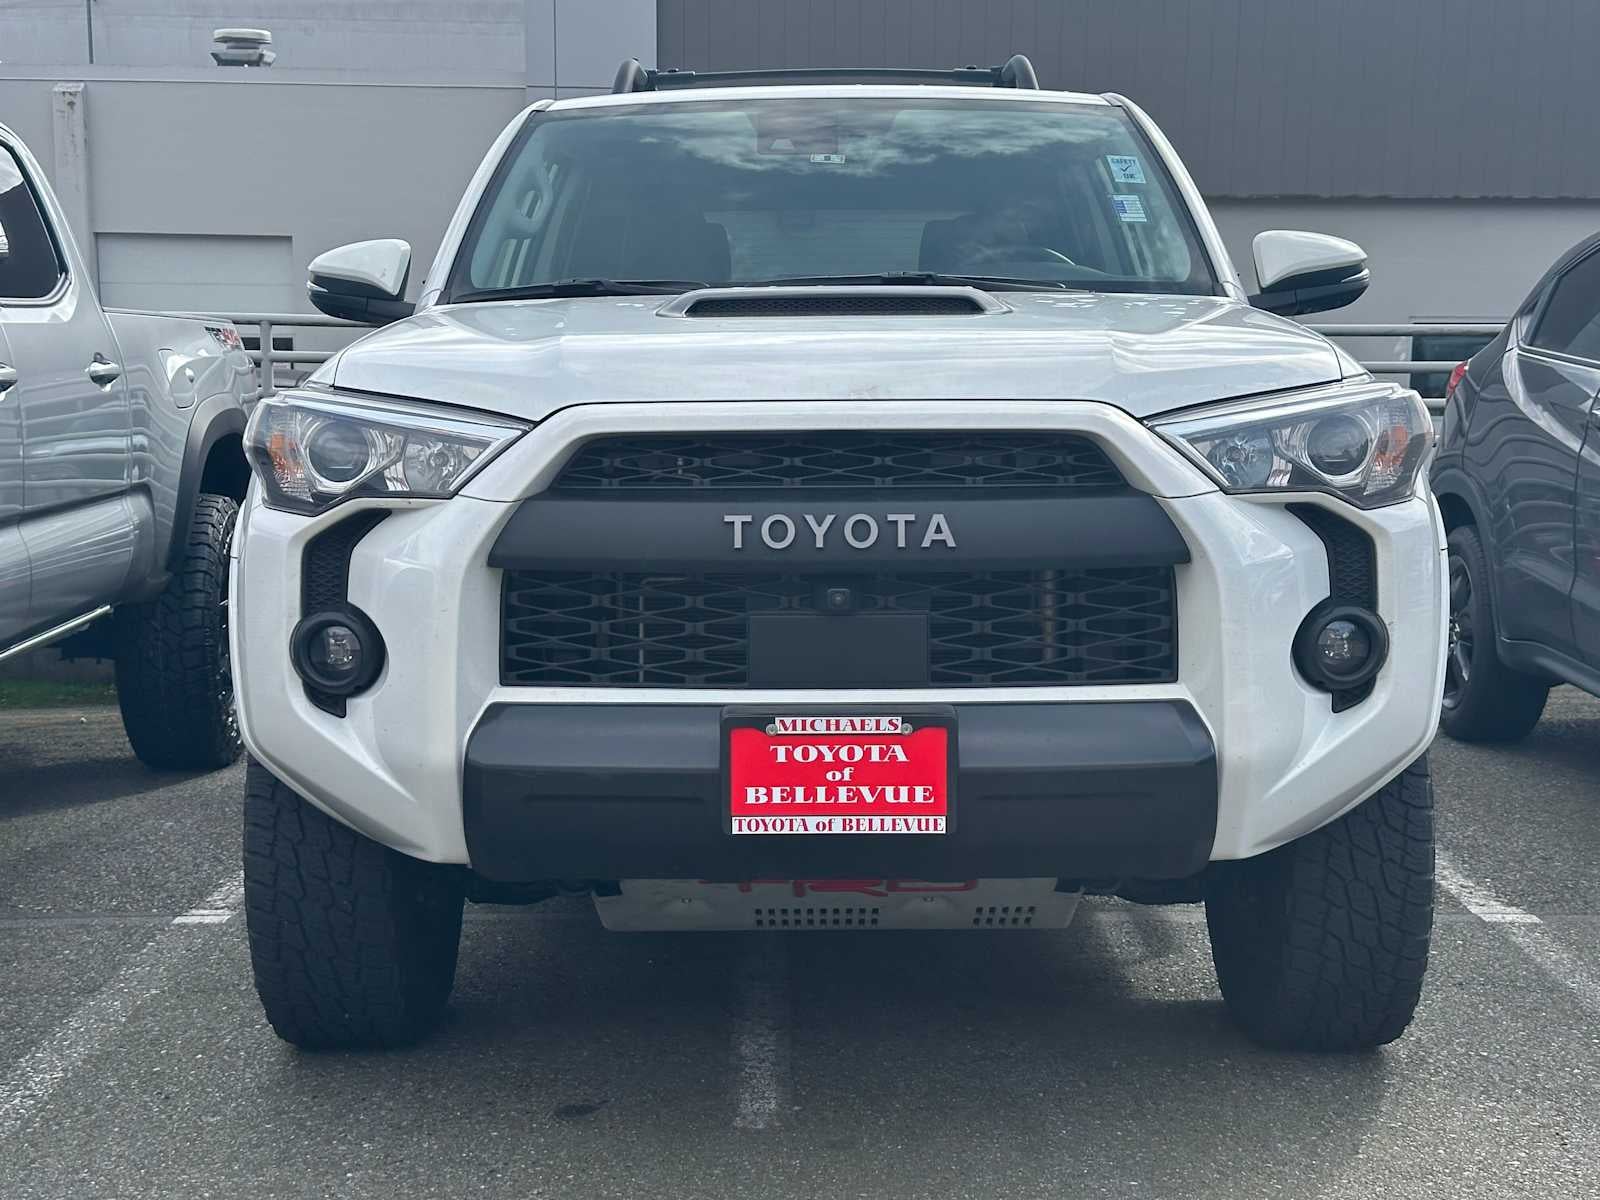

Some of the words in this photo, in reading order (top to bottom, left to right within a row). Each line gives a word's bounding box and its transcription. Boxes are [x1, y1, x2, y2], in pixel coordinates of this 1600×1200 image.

[723, 513, 957, 550] TOYOTA
[778, 718, 899, 732] MICHAELS
[770, 744, 910, 763] TOYOTA
[825, 767, 854, 782] of
[744, 785, 935, 804] BELLEVUE
[734, 817, 809, 832] TOYOTA
[816, 817, 835, 832] of
[842, 817, 944, 832] BELLEVUE
